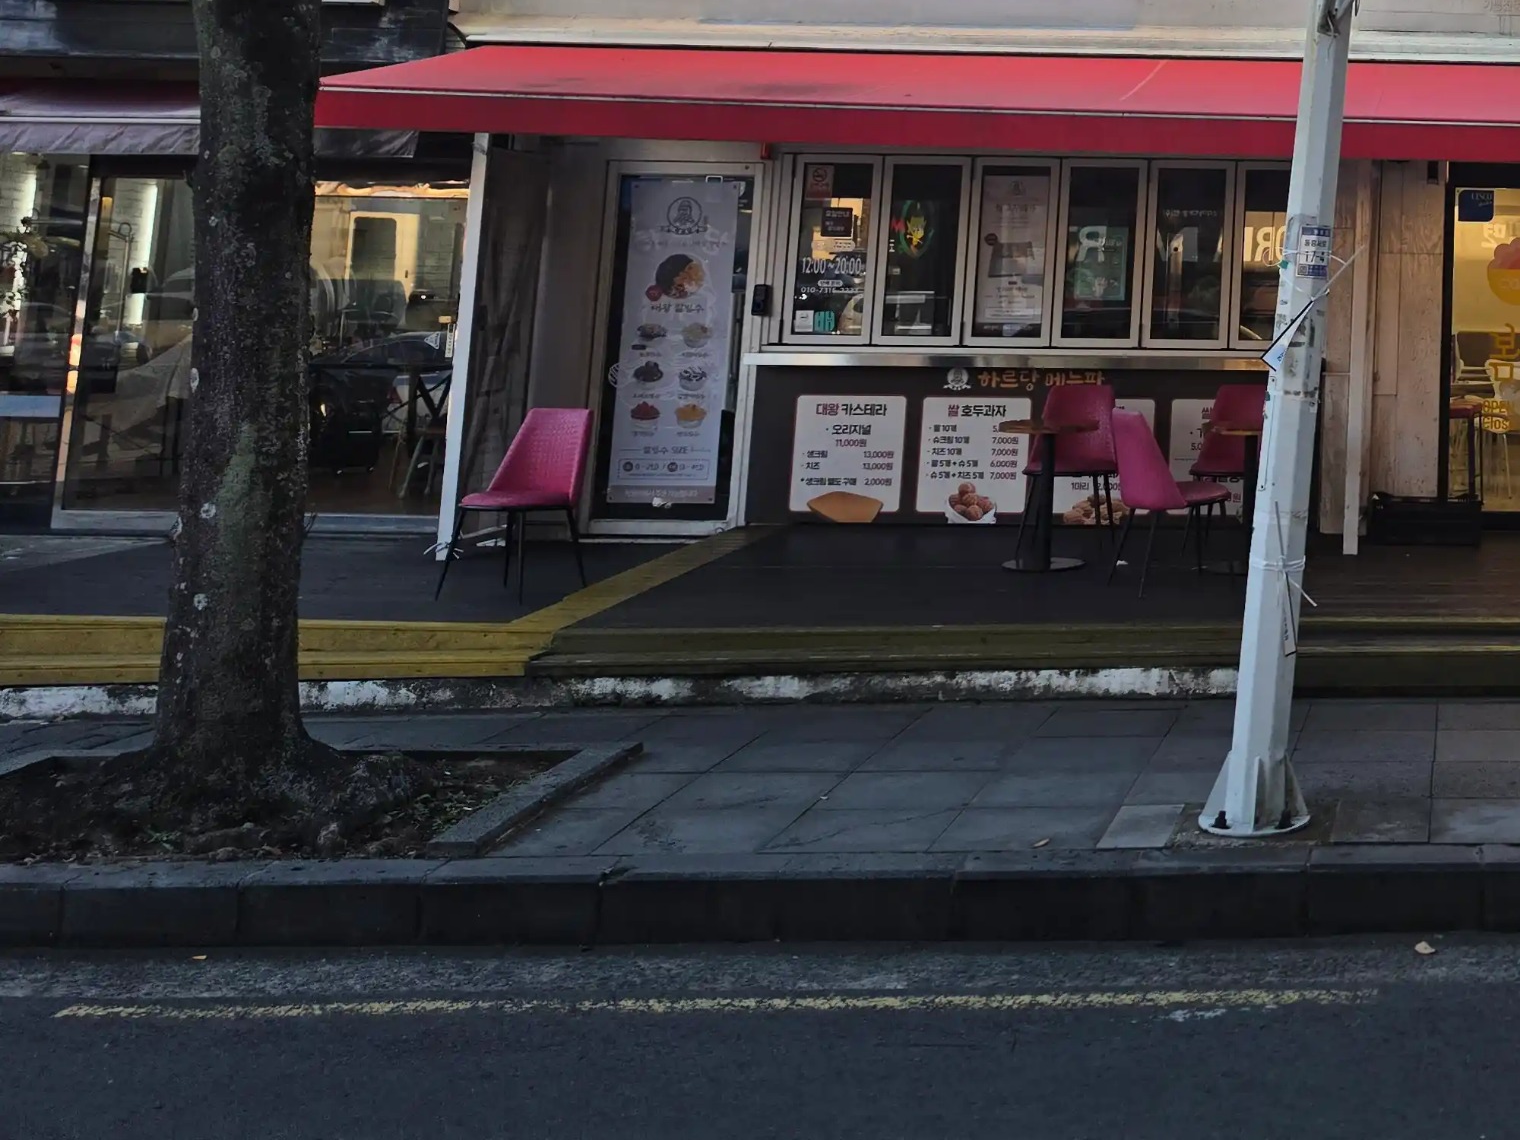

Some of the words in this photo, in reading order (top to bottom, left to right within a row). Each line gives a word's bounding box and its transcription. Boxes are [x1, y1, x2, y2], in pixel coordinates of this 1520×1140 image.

[978, 370, 1040, 391] 하르당
[816, 403, 839, 416] 대왕
[841, 403, 887, 416] 카스테라
[948, 404, 959, 417] 쌀
[961, 405, 1007, 417] 호두과자
[832, 424, 871, 435] 오리지널
[836, 439, 867, 448] 11,000원
[992, 437, 1019, 445] 7,000원
[863, 451, 894, 459] 13,000원
[932, 447, 946, 455] 치즈
[991, 448, 1018, 457] 7,000원
[805, 462, 820, 470] 치즈
[990, 460, 1018, 469] 6,000원
[957, 471, 971, 479] 치즈
[990, 471, 1017, 480] 7,000원
[864, 478, 892, 487] 2,000원
